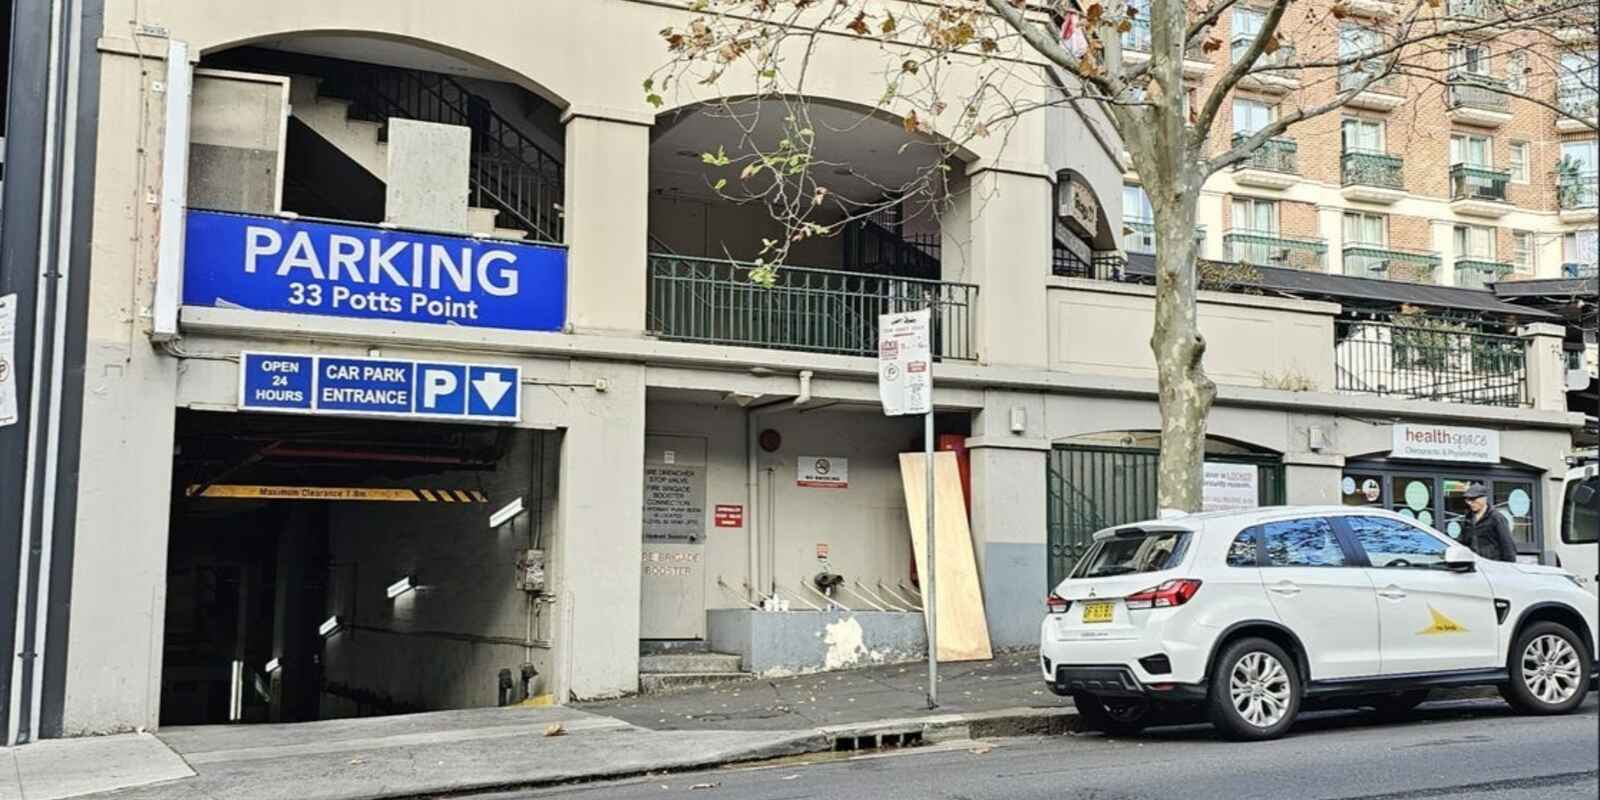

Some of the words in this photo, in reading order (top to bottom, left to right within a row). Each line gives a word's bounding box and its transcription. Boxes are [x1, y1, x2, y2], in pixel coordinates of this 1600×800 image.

[244, 226, 520, 297] PARKING
[288, 282, 322, 307] 33
[331, 286, 402, 314] Potts
[410, 292, 478, 320] Point
[261, 360, 299, 373] OPEN
[326, 364, 359, 381] CAR
[363, 366, 406, 382] PARK
[272, 375, 288, 387] 24
[424, 369, 458, 409] P
[255, 389, 304, 402] HOURS
[322, 388, 407, 405] ENTRANCE
[1406, 426, 1488, 449] healthspace
[259, 487, 299, 496] Maximum
[301, 488, 342, 497] Clearance
